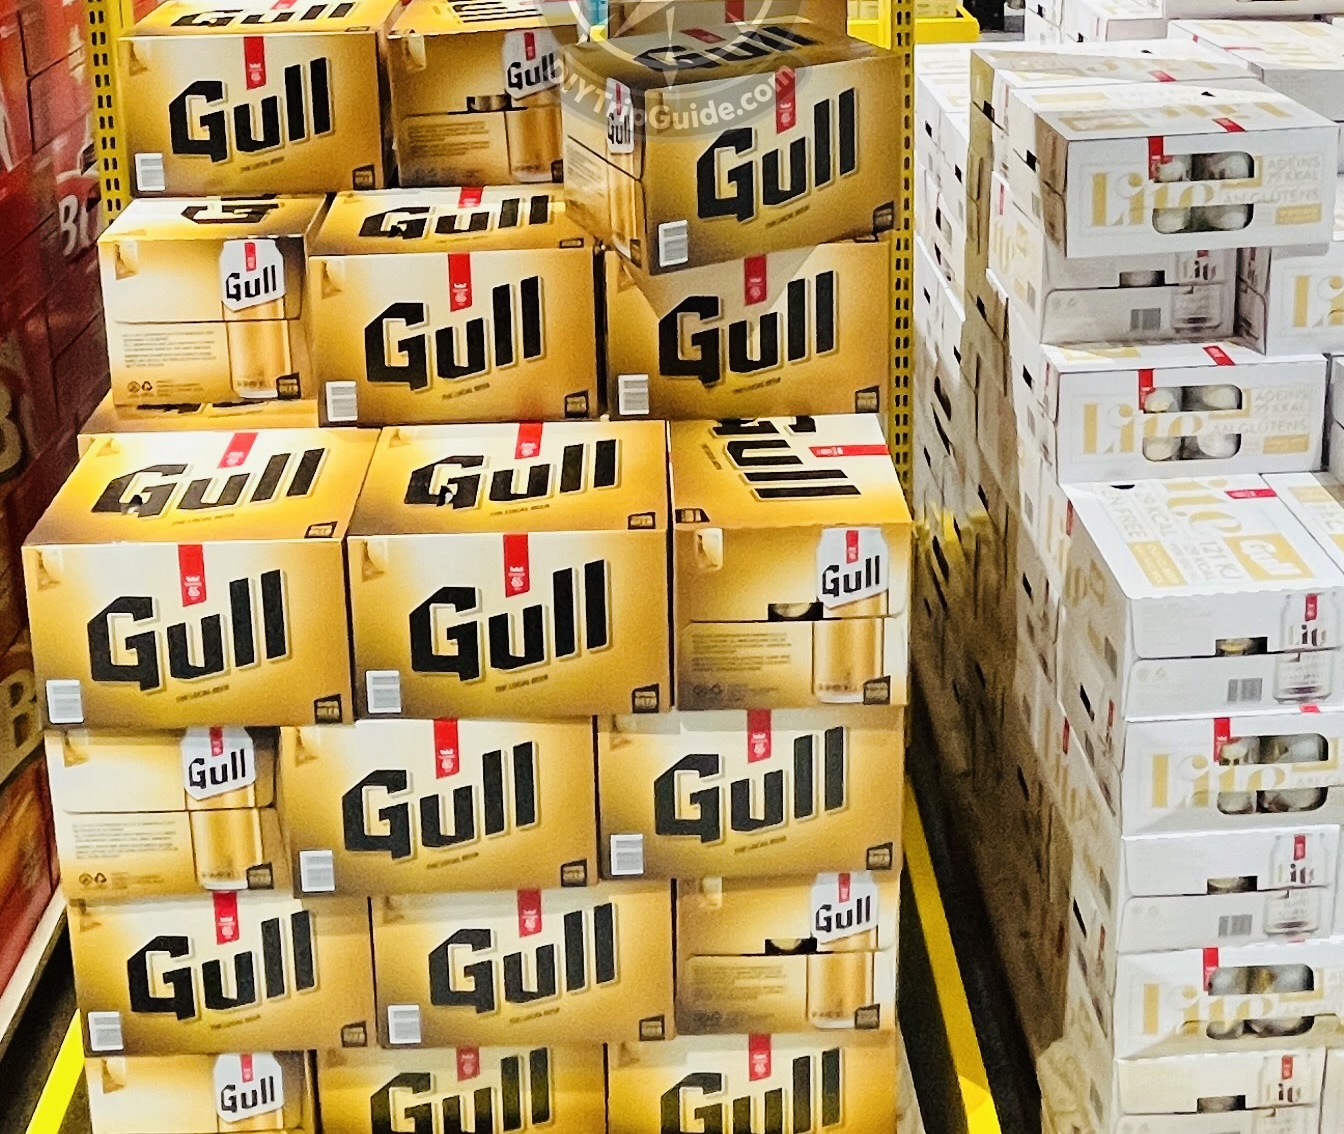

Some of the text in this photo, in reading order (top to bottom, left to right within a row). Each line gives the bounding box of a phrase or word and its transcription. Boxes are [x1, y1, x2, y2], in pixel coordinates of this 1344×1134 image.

[168, 56, 333, 164] Gull
[696, 88, 858, 223] Gull
[359, 194, 550, 240] Gull
[225, 265, 277, 302] Gull
[658, 270, 838, 387] Gull
[364, 275, 545, 392] Gull
[91, 447, 328, 519] Gull
[404, 439, 621, 511] Gull
[408, 558, 613, 683] Gull
[821, 555, 881, 597] Gull
[87, 569, 291, 692] Gull
[188, 748, 247, 790] Gull
[341, 741, 538, 859] Gull
[654, 725, 846, 844] Gull
[428, 902, 618, 1015] Gull
[814, 895, 872, 933] Gull
[126, 909, 318, 1021] Gull
[220, 1075, 276, 1114] Gull
[370, 1046, 552, 1134] Gull
[660, 1047, 843, 1134] Gull
